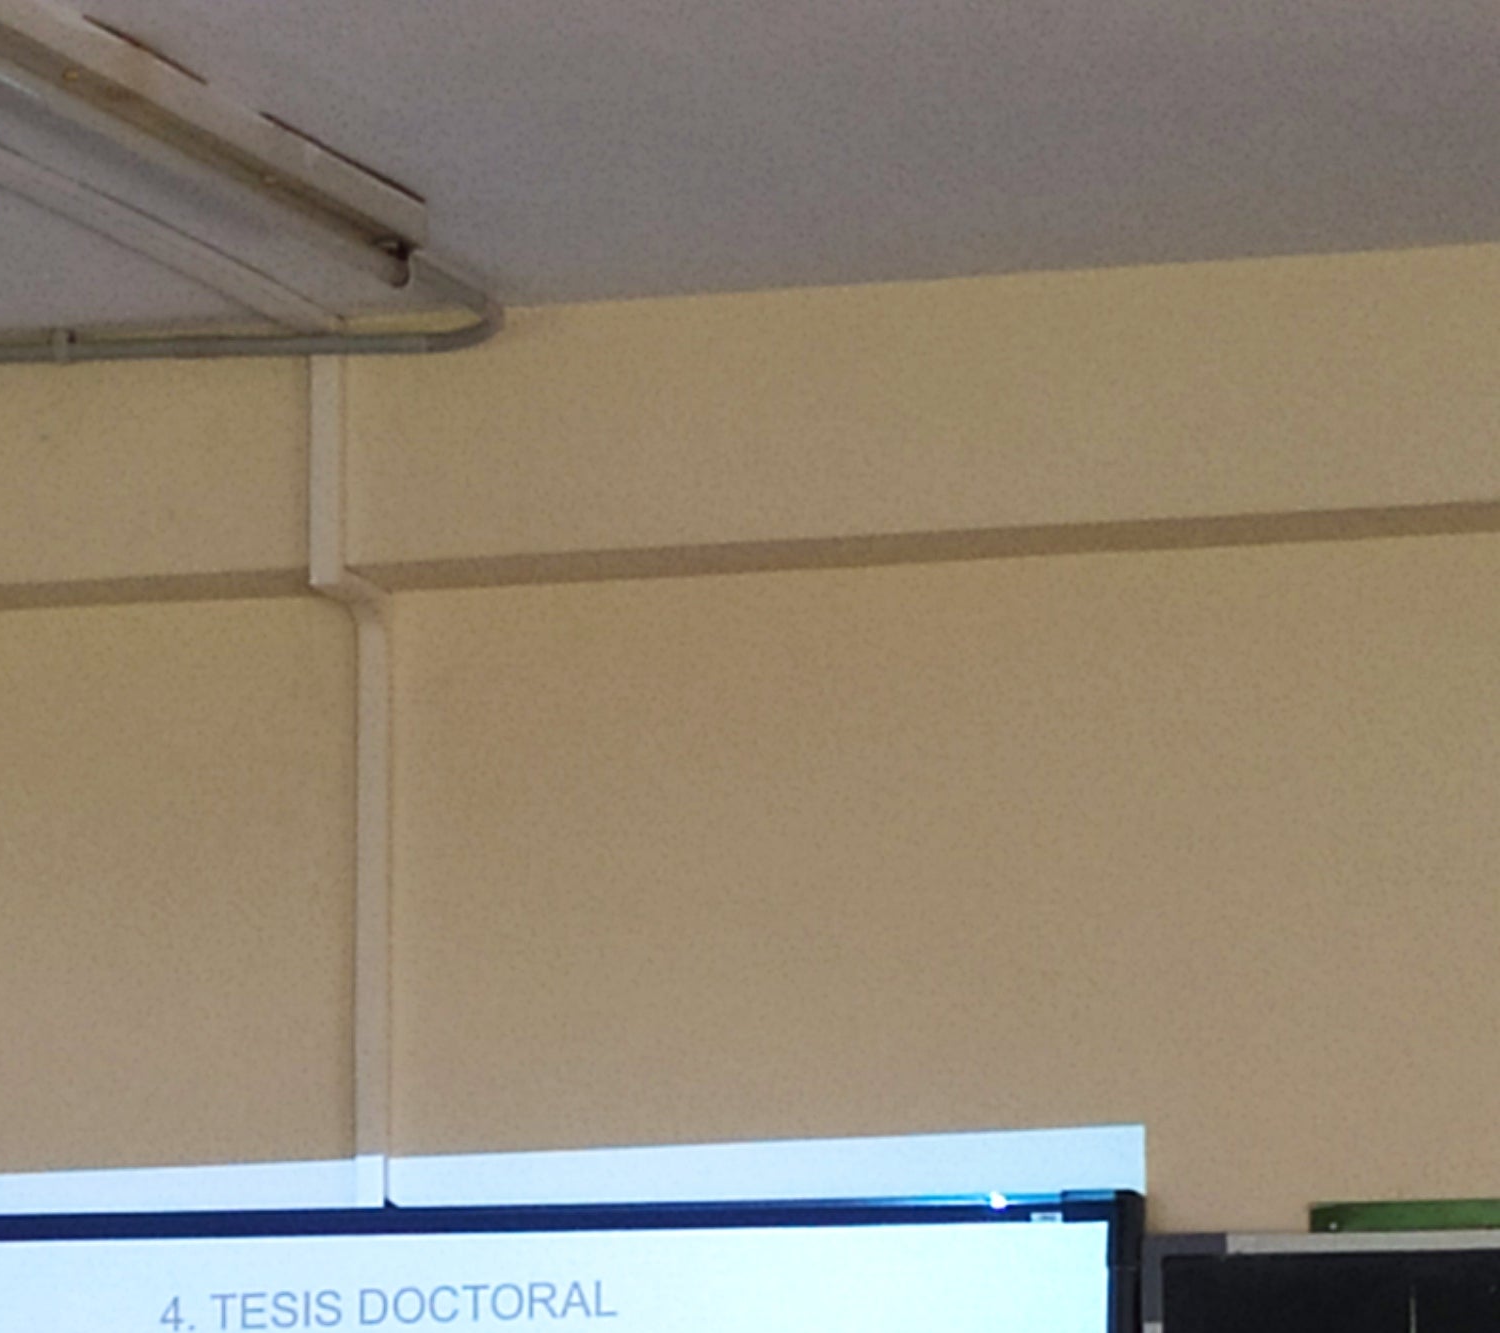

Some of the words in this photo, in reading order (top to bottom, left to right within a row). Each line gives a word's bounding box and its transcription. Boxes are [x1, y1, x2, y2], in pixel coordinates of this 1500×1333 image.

[159, 1297, 195, 1332] 4.
[210, 1289, 343, 1331] TESIS
[358, 1280, 618, 1326] DOCTORAL
